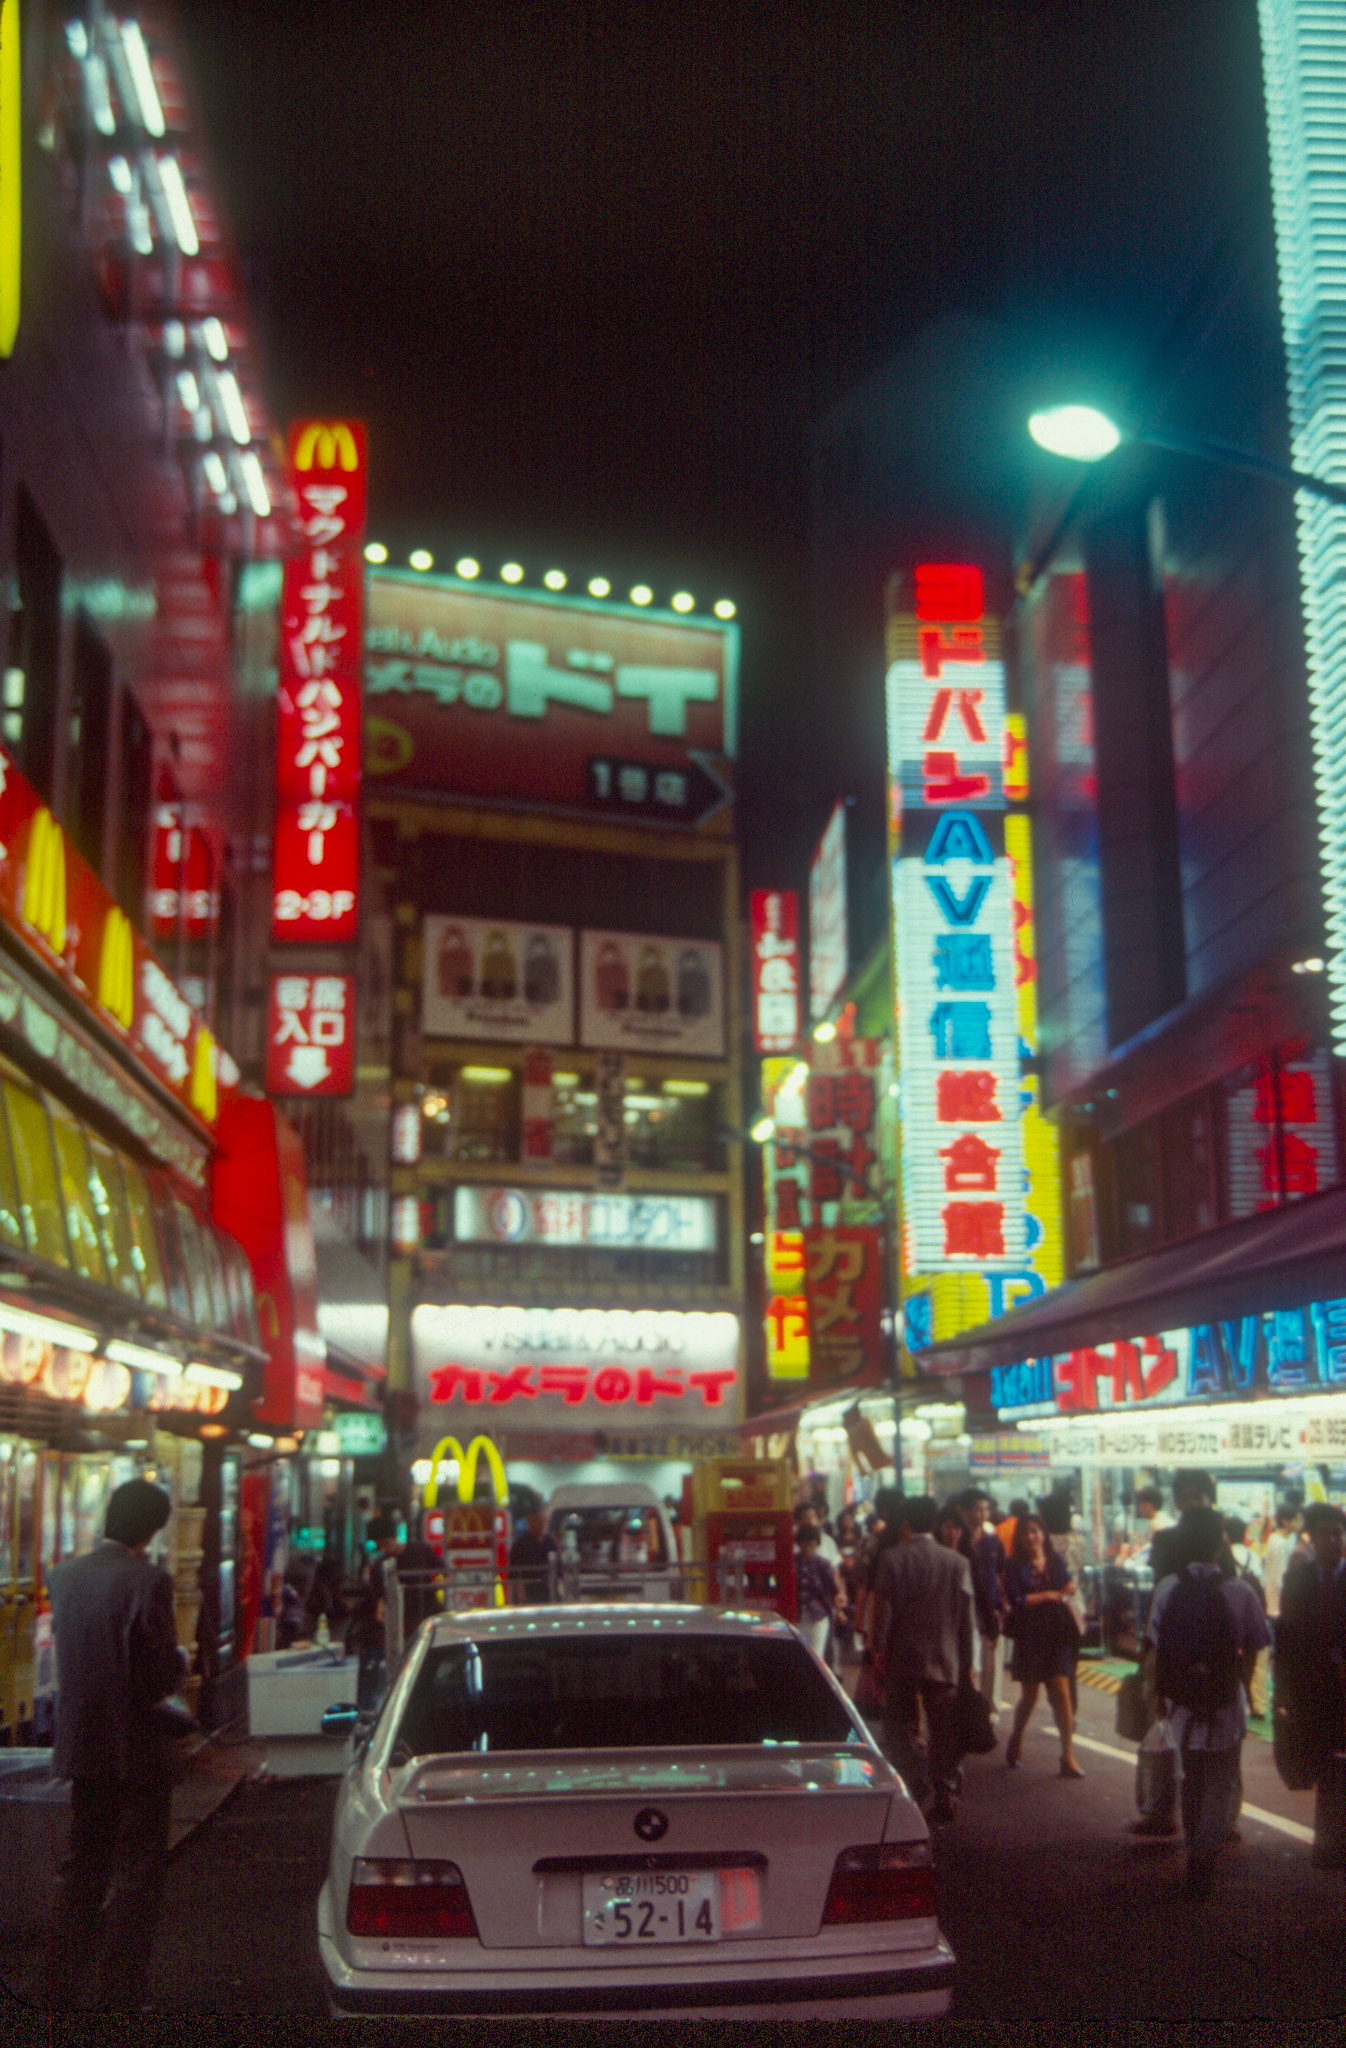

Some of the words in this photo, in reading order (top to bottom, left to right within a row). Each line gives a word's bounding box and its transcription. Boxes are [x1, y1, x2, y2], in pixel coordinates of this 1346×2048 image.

[274, 1009, 345, 1046] 入口
[428, 1363, 738, 1406] カメラのドイ
[613, 1899, 713, 1938] 52-14
